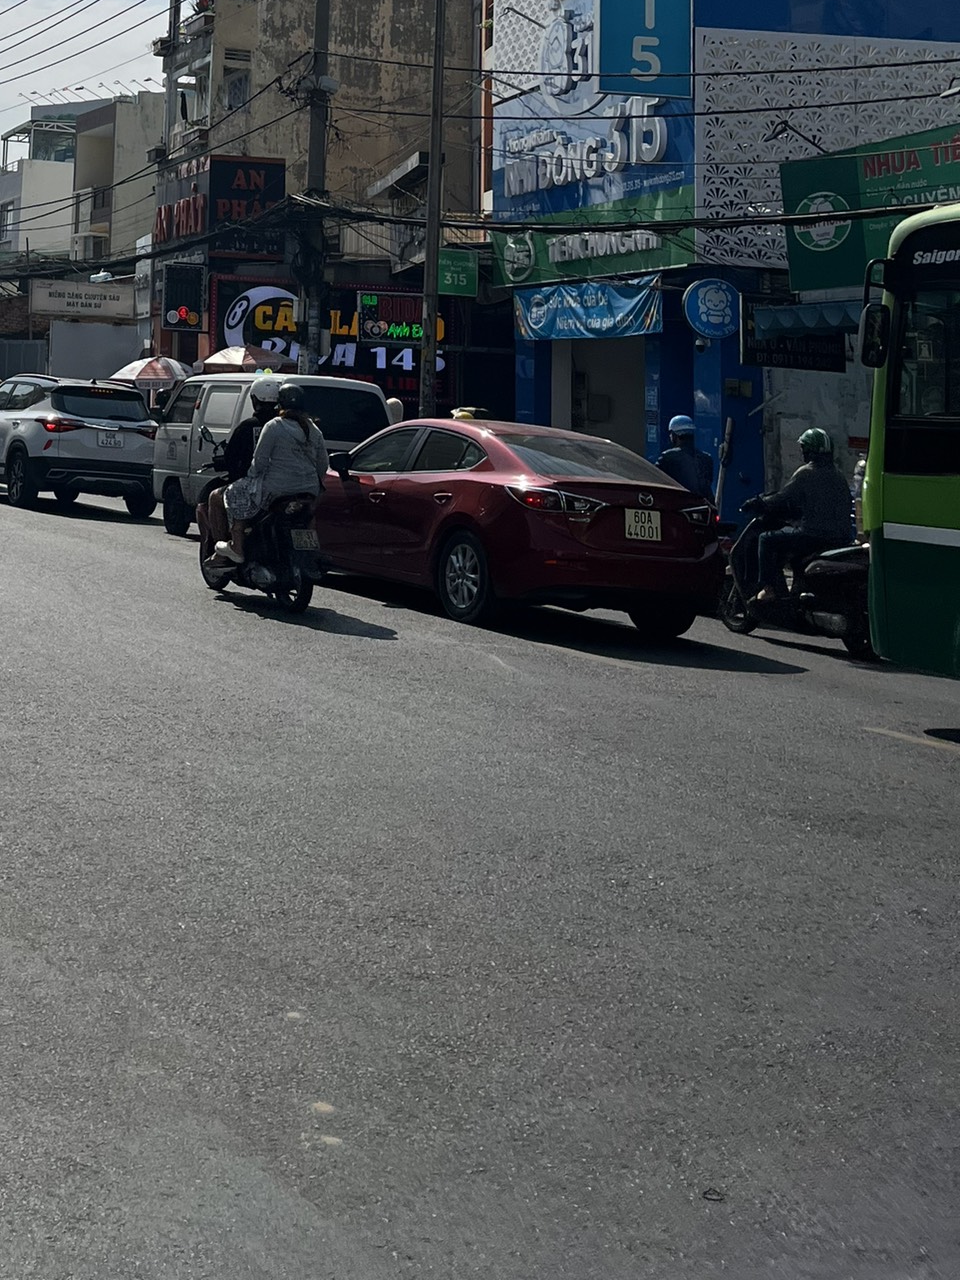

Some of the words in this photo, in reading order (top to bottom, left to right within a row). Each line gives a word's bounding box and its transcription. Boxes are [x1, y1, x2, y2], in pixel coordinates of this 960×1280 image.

[602, 97, 668, 173] 315
[231, 168, 266, 192] AN
[444, 272, 467, 286] 315
[386, 321, 411, 340] Anh
[587, 314, 602, 329] của
[602, 313, 614, 331] gia
[634, 511, 653, 525] 60A
[627, 525, 659, 539] 440.01
